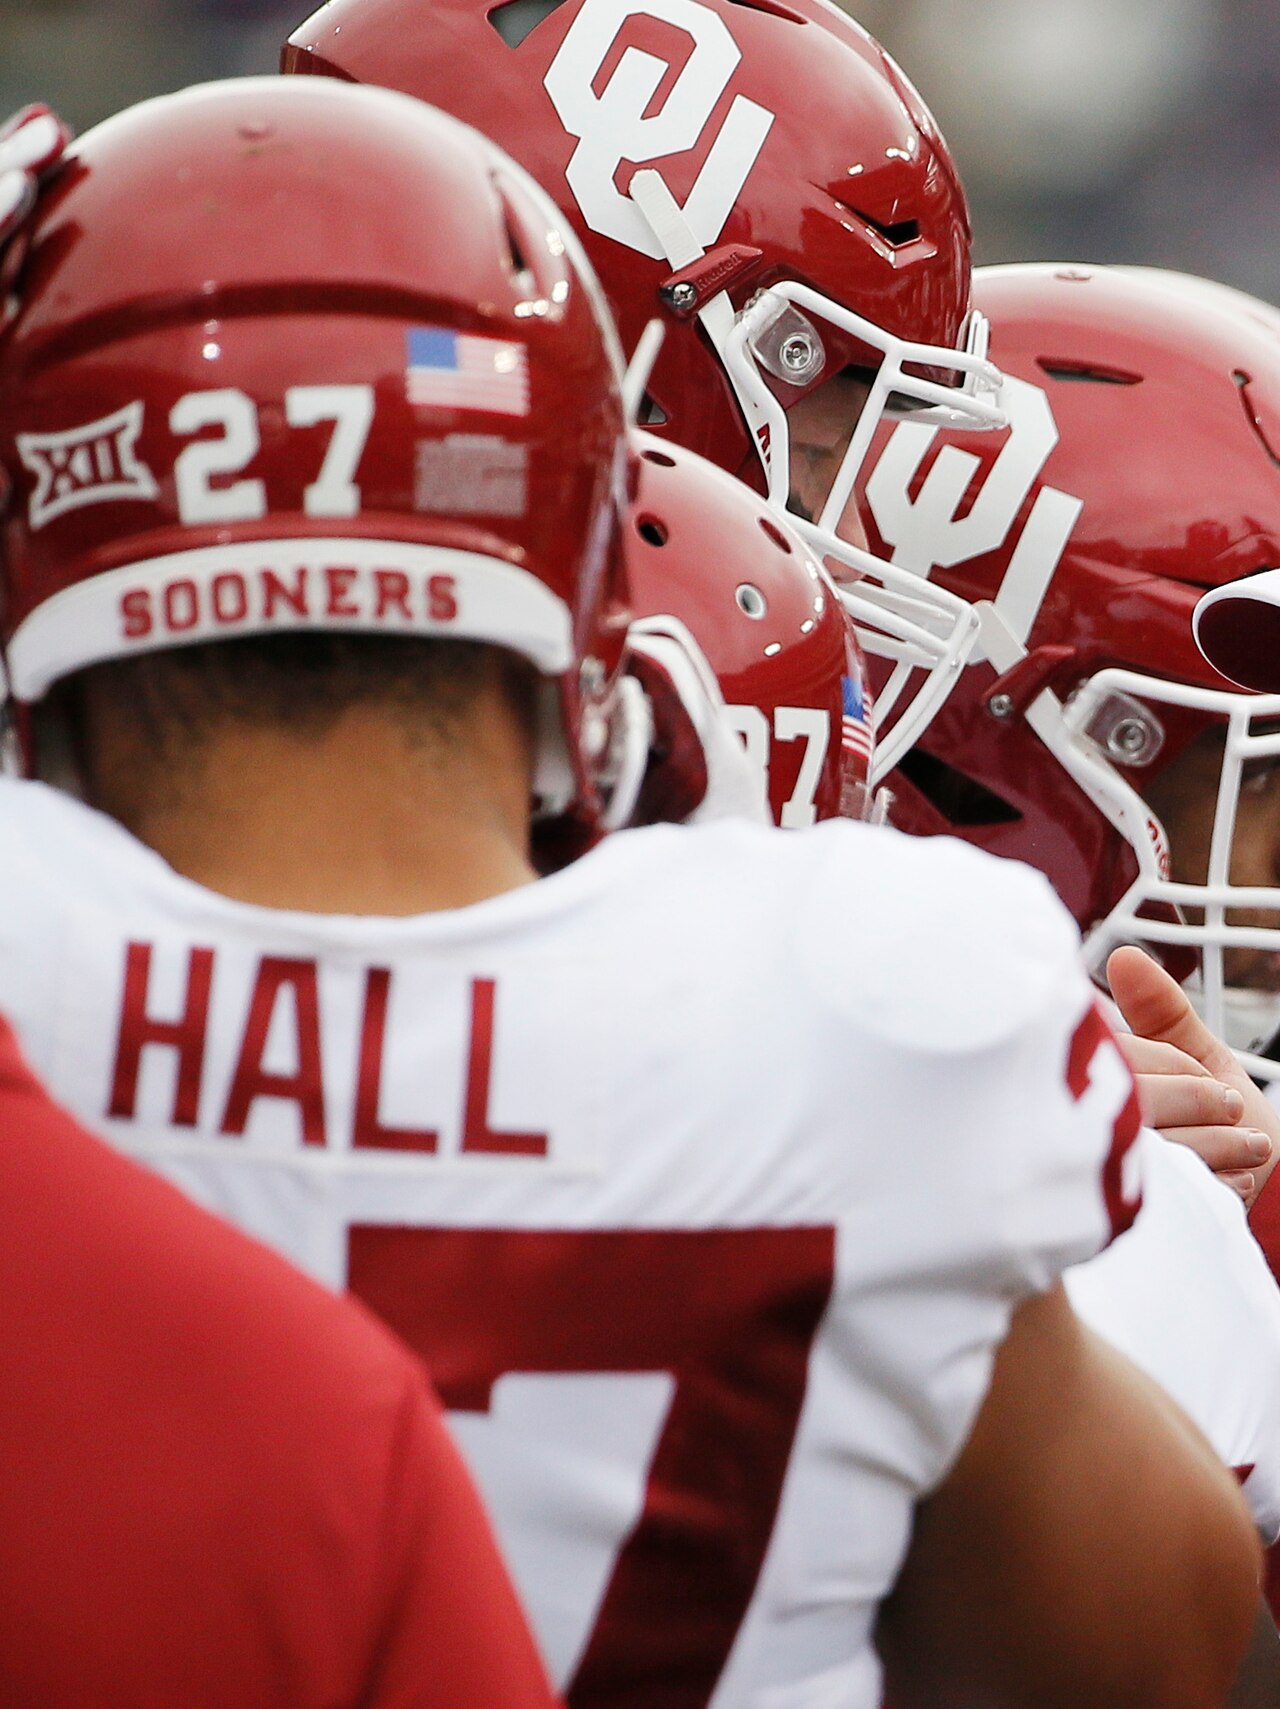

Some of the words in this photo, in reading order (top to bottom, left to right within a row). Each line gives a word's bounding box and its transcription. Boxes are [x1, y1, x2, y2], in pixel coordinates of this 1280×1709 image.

[543, 0, 776, 261] OU
[168, 384, 375, 527] 27
[120, 565, 459, 640] SOONERS
[107, 941, 549, 1156] HALL
